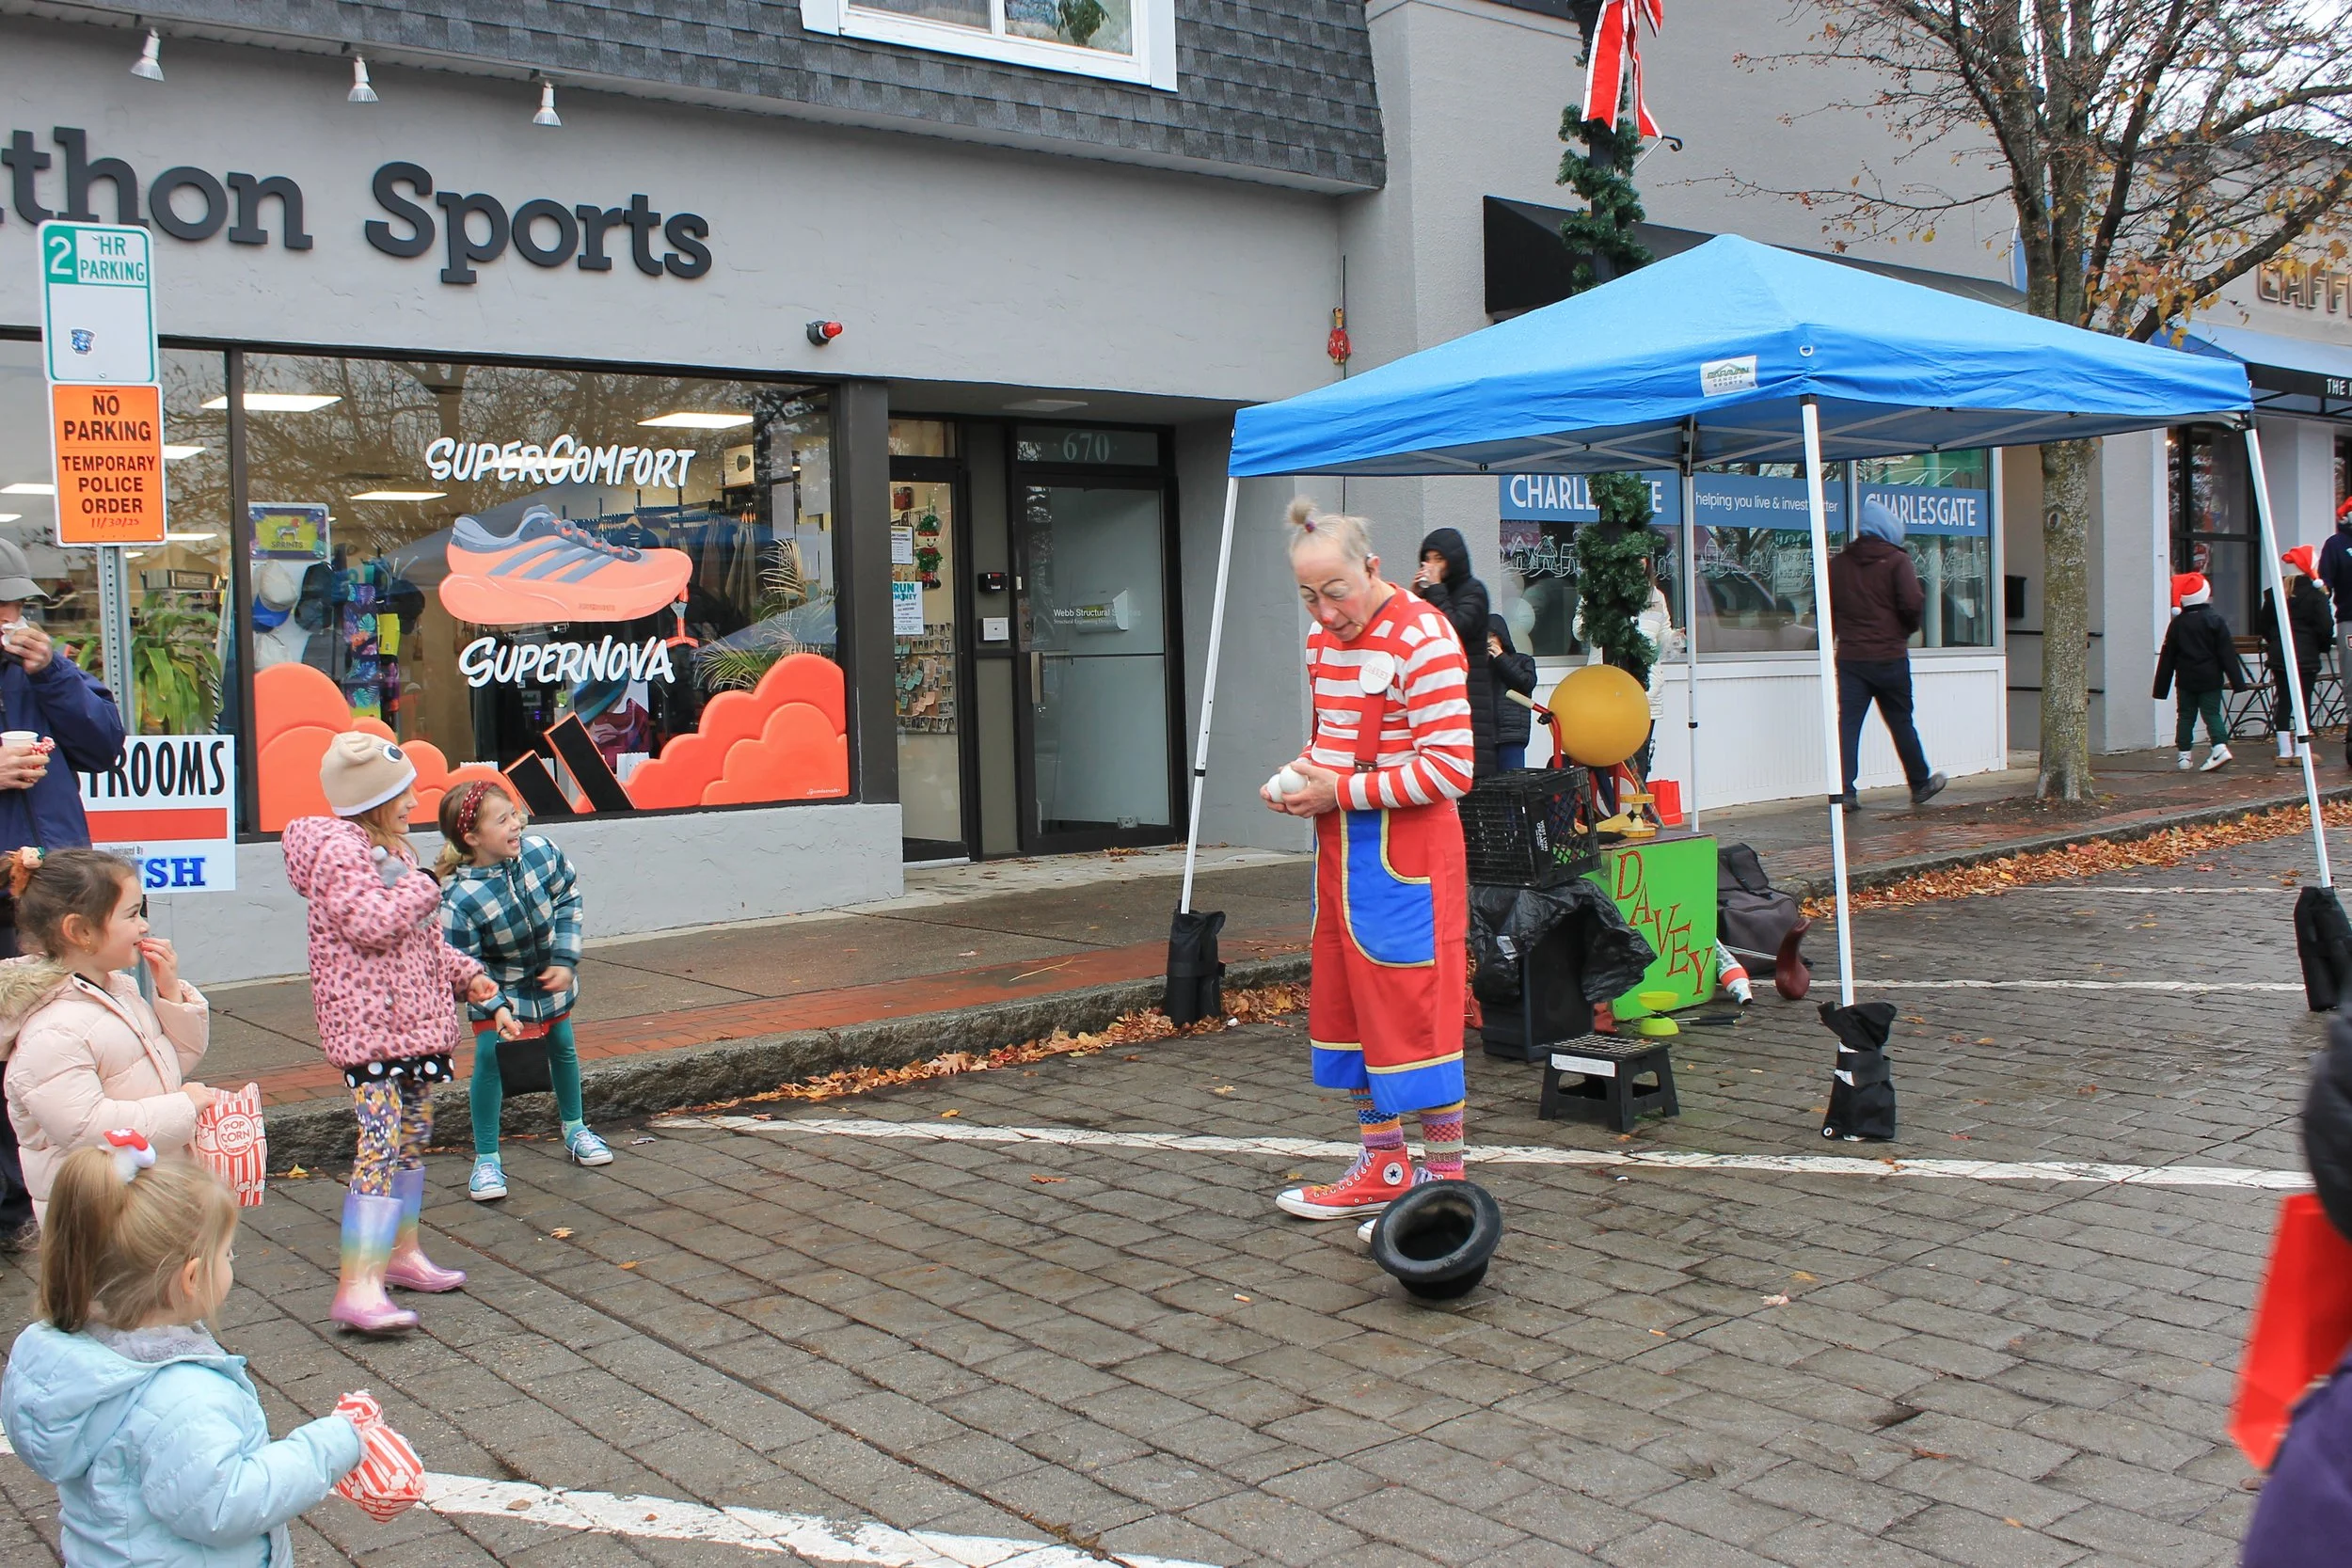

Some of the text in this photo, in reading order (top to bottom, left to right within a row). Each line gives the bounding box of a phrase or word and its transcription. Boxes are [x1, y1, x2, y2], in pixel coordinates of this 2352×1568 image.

[0, 126, 713, 284] thon Sports
[49, 236, 127, 276] 2 HR
[80, 260, 145, 281] PARKING
[2256, 262, 2352, 318] CAFF
[2326, 378, 2346, 395] THE
[92, 395, 120, 416] NO
[63, 420, 151, 442] PARKING
[1063, 433, 1110, 463] 670
[62, 455, 155, 471] TEMPORARY
[424, 434, 697, 489] SUPERCOMFORT
[78, 477, 144, 493] POLICE
[81, 498, 143, 514] ORDER
[1695, 491, 1732, 511] helping
[1734, 496, 1753, 511] you
[1755, 495, 1770, 509] live
[1772, 496, 1780, 510] &
[1782, 496, 1808, 511] invest
[1864, 493, 1977, 527] ARLESGATE
[893, 582, 914, 594] RUN
[1053, 608, 1074, 617] Webb
[1075, 608, 1110, 617] Structural
[458, 634, 676, 689] SUPERNOVA
[77, 740, 226, 798] ROOMS
[137, 856, 207, 888] SH
[1615, 849, 1714, 996] DAVEY
[223, 1120, 246, 1130] POP
[220, 1130, 250, 1143] CORN
